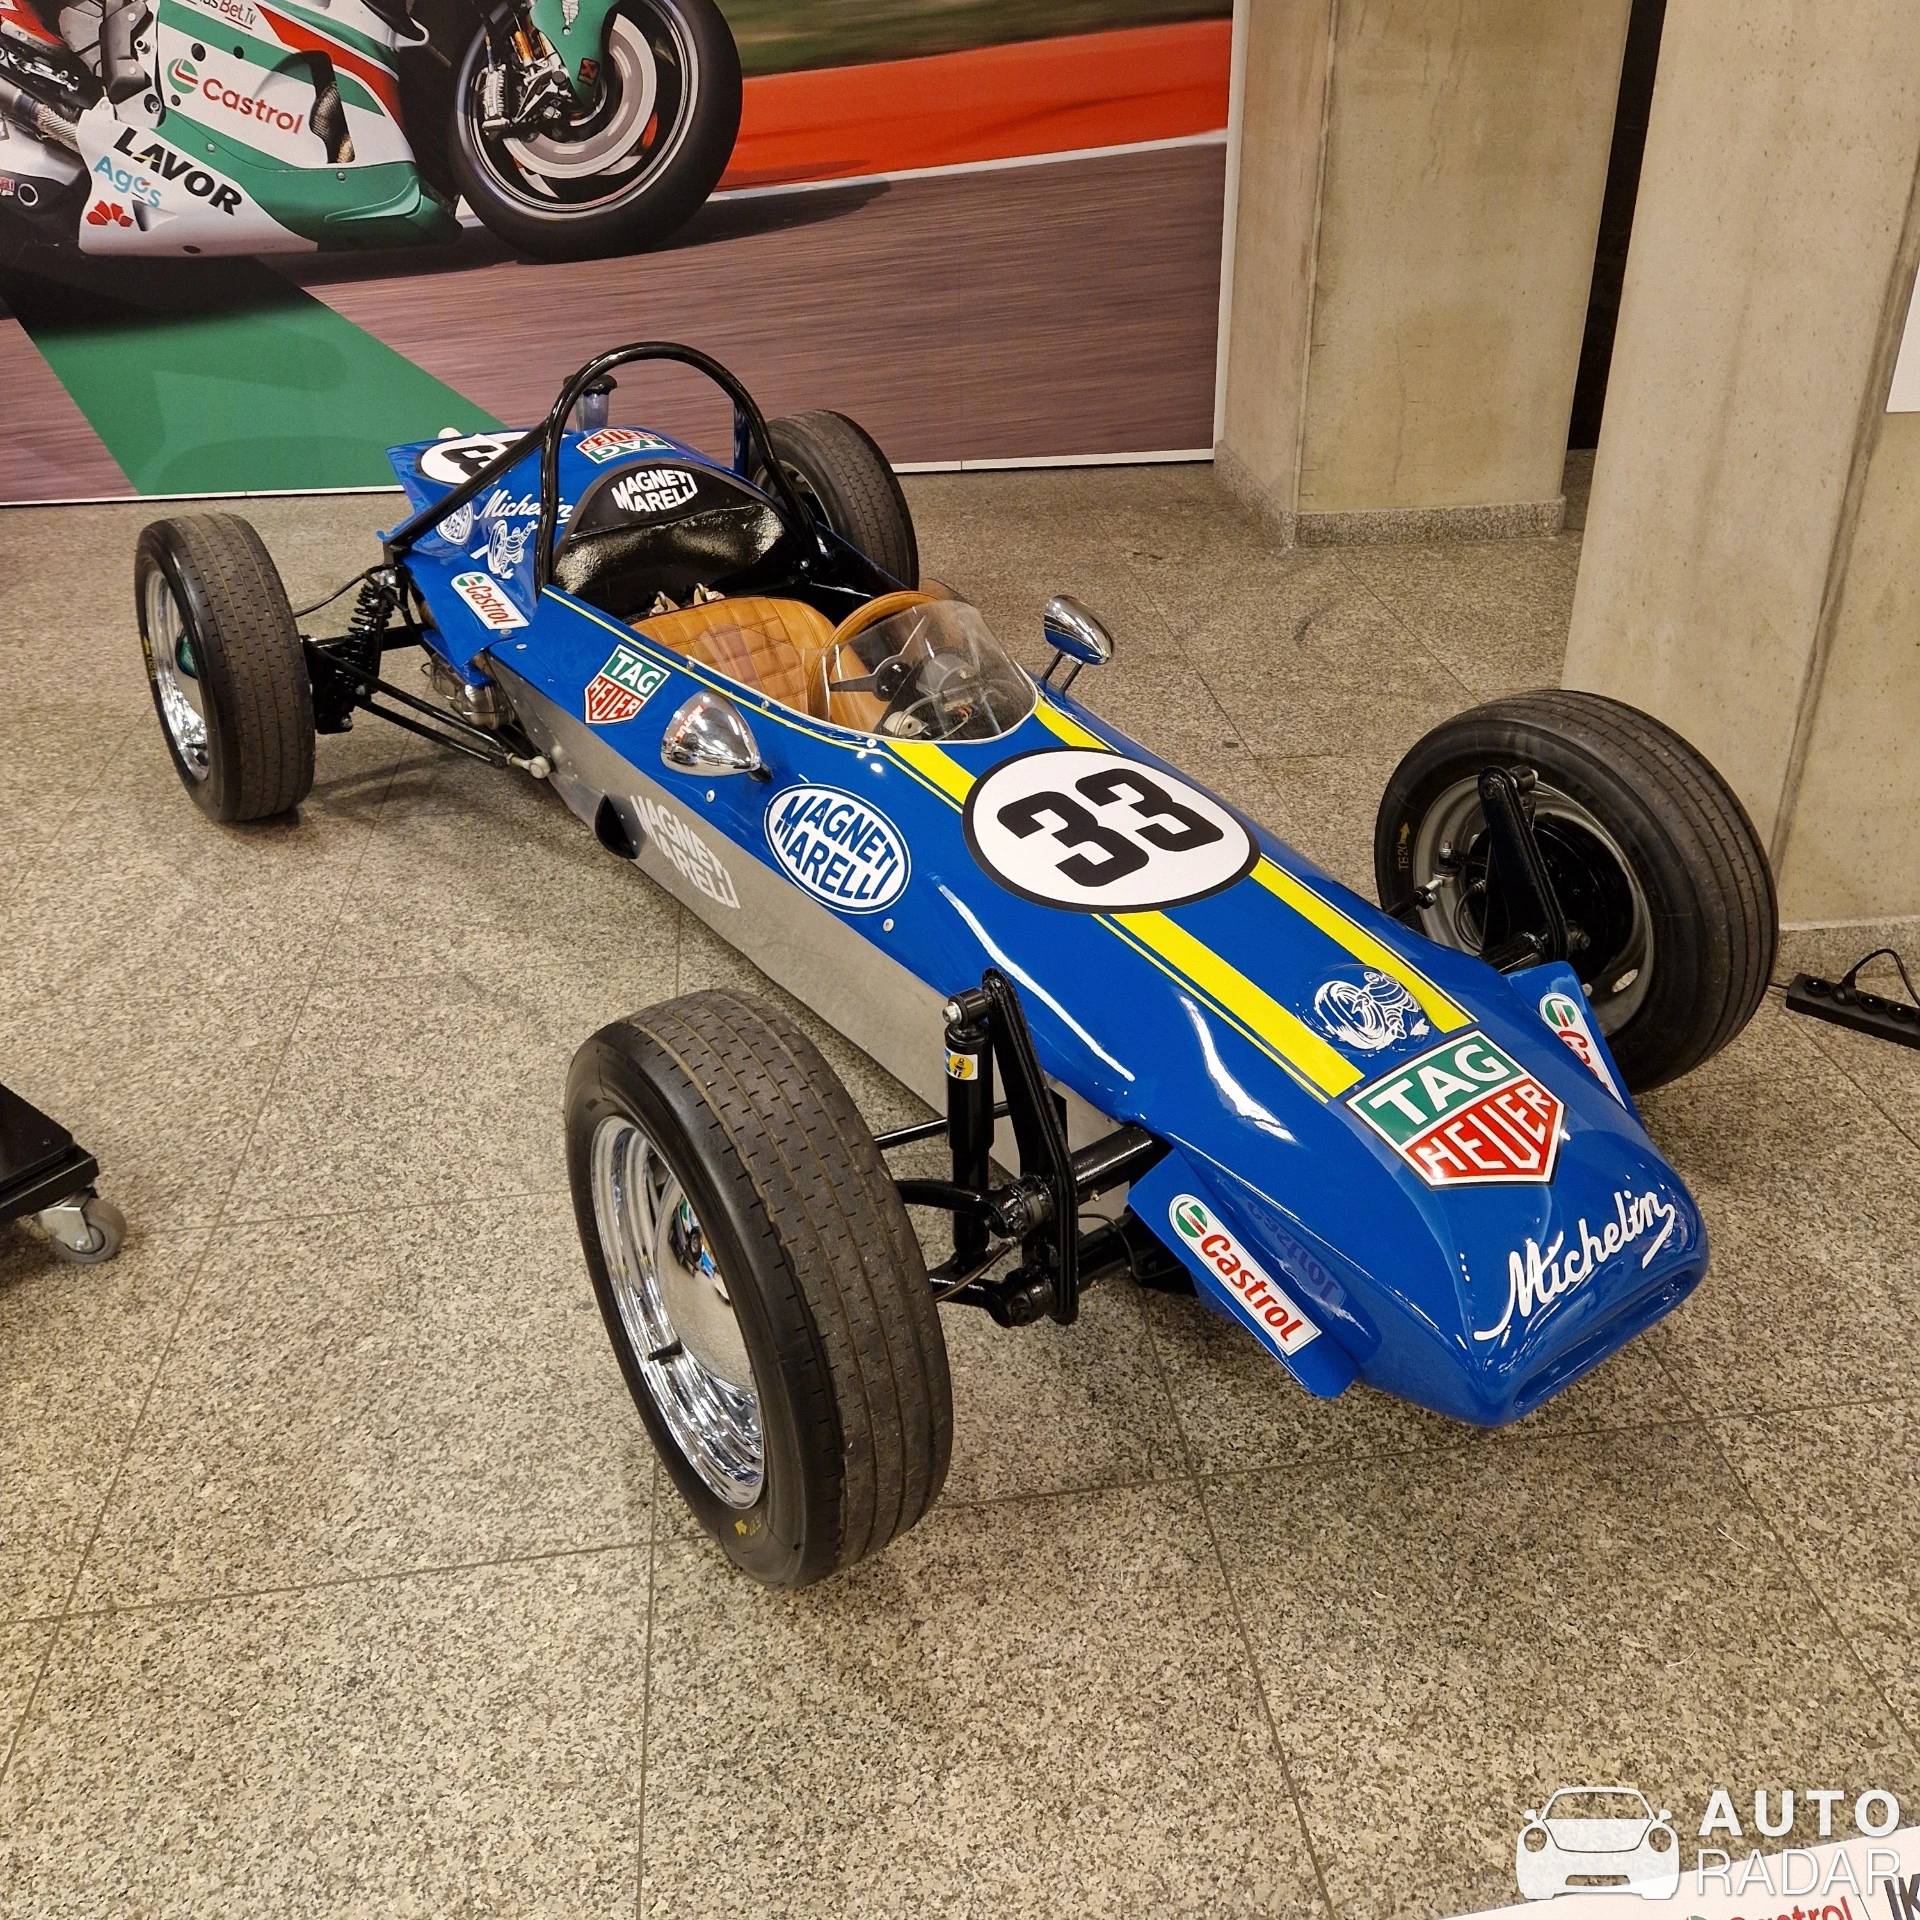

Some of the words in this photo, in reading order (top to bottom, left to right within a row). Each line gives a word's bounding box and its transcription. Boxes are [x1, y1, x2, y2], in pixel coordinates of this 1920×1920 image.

[203, 78, 304, 134] Castrol
[94, 155, 162, 207] Agos
[113, 127, 242, 216] LAVOR
[597, 440, 668, 458] TAG
[474, 489, 574, 524] Michein
[611, 469, 698, 498] MAGNETI
[611, 485, 698, 512] MARELLI
[465, 586, 518, 625] Castrol
[590, 677, 641, 720] HEUER
[611, 652, 661, 694] TAG
[630, 796, 738, 895] MAGNETI
[774, 819, 898, 900] MARELLI
[779, 796, 899, 873] MAGNETI
[997, 768, 1224, 887] 33
[1369, 1044, 1510, 1126] TAG
[1415, 1084, 1551, 1178] HEUER
[1201, 1234, 1304, 1342] Castrol
[1473, 1190, 1676, 1341] Michelin
